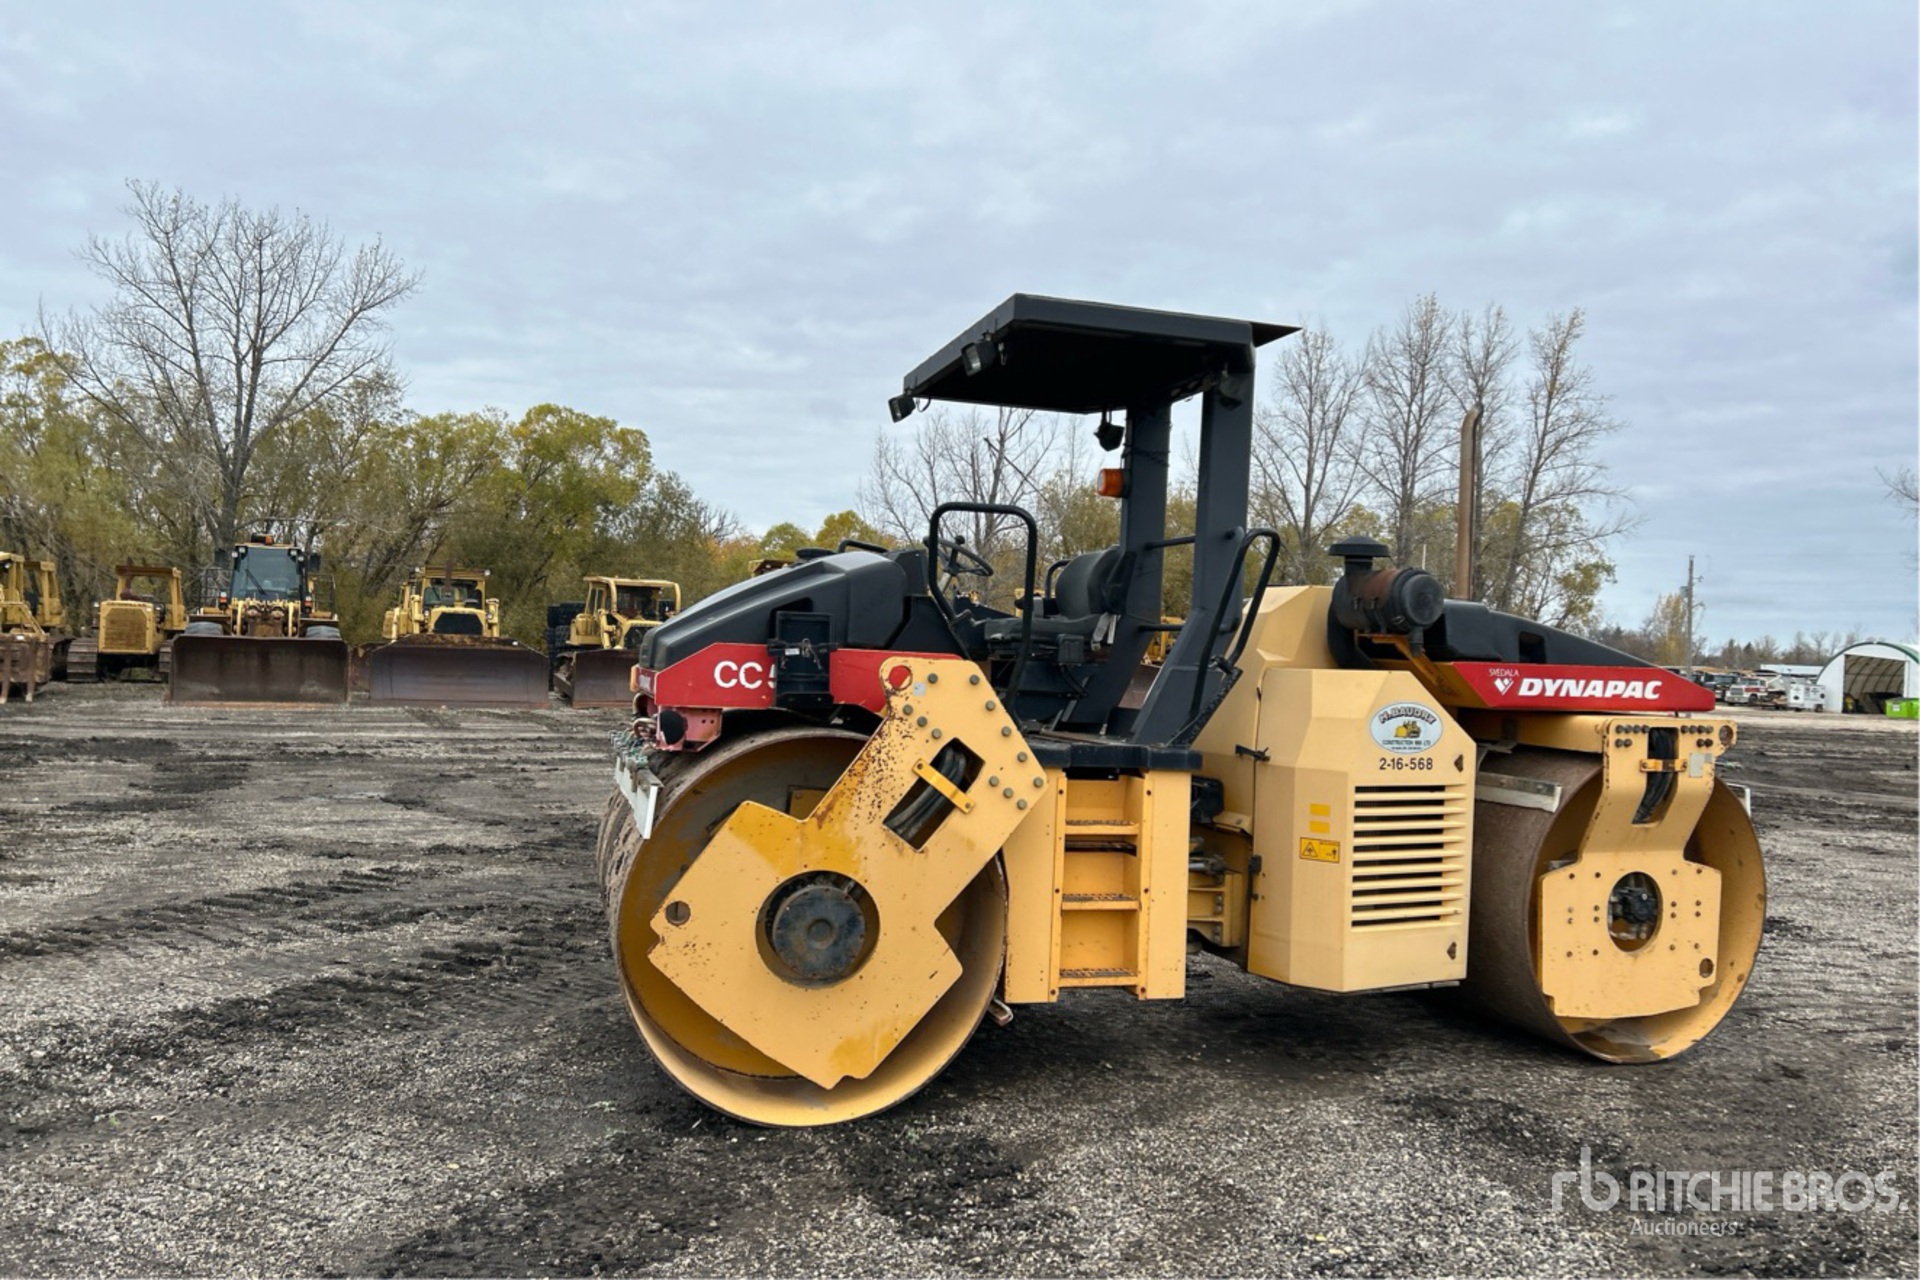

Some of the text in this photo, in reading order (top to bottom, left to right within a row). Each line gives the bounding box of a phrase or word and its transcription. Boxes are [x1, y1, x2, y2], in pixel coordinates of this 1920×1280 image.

[1488, 668, 1520, 677] SVEDALA
[1518, 678, 1662, 700] DYNAPAC
[1379, 757, 1433, 771] 2-16-568
